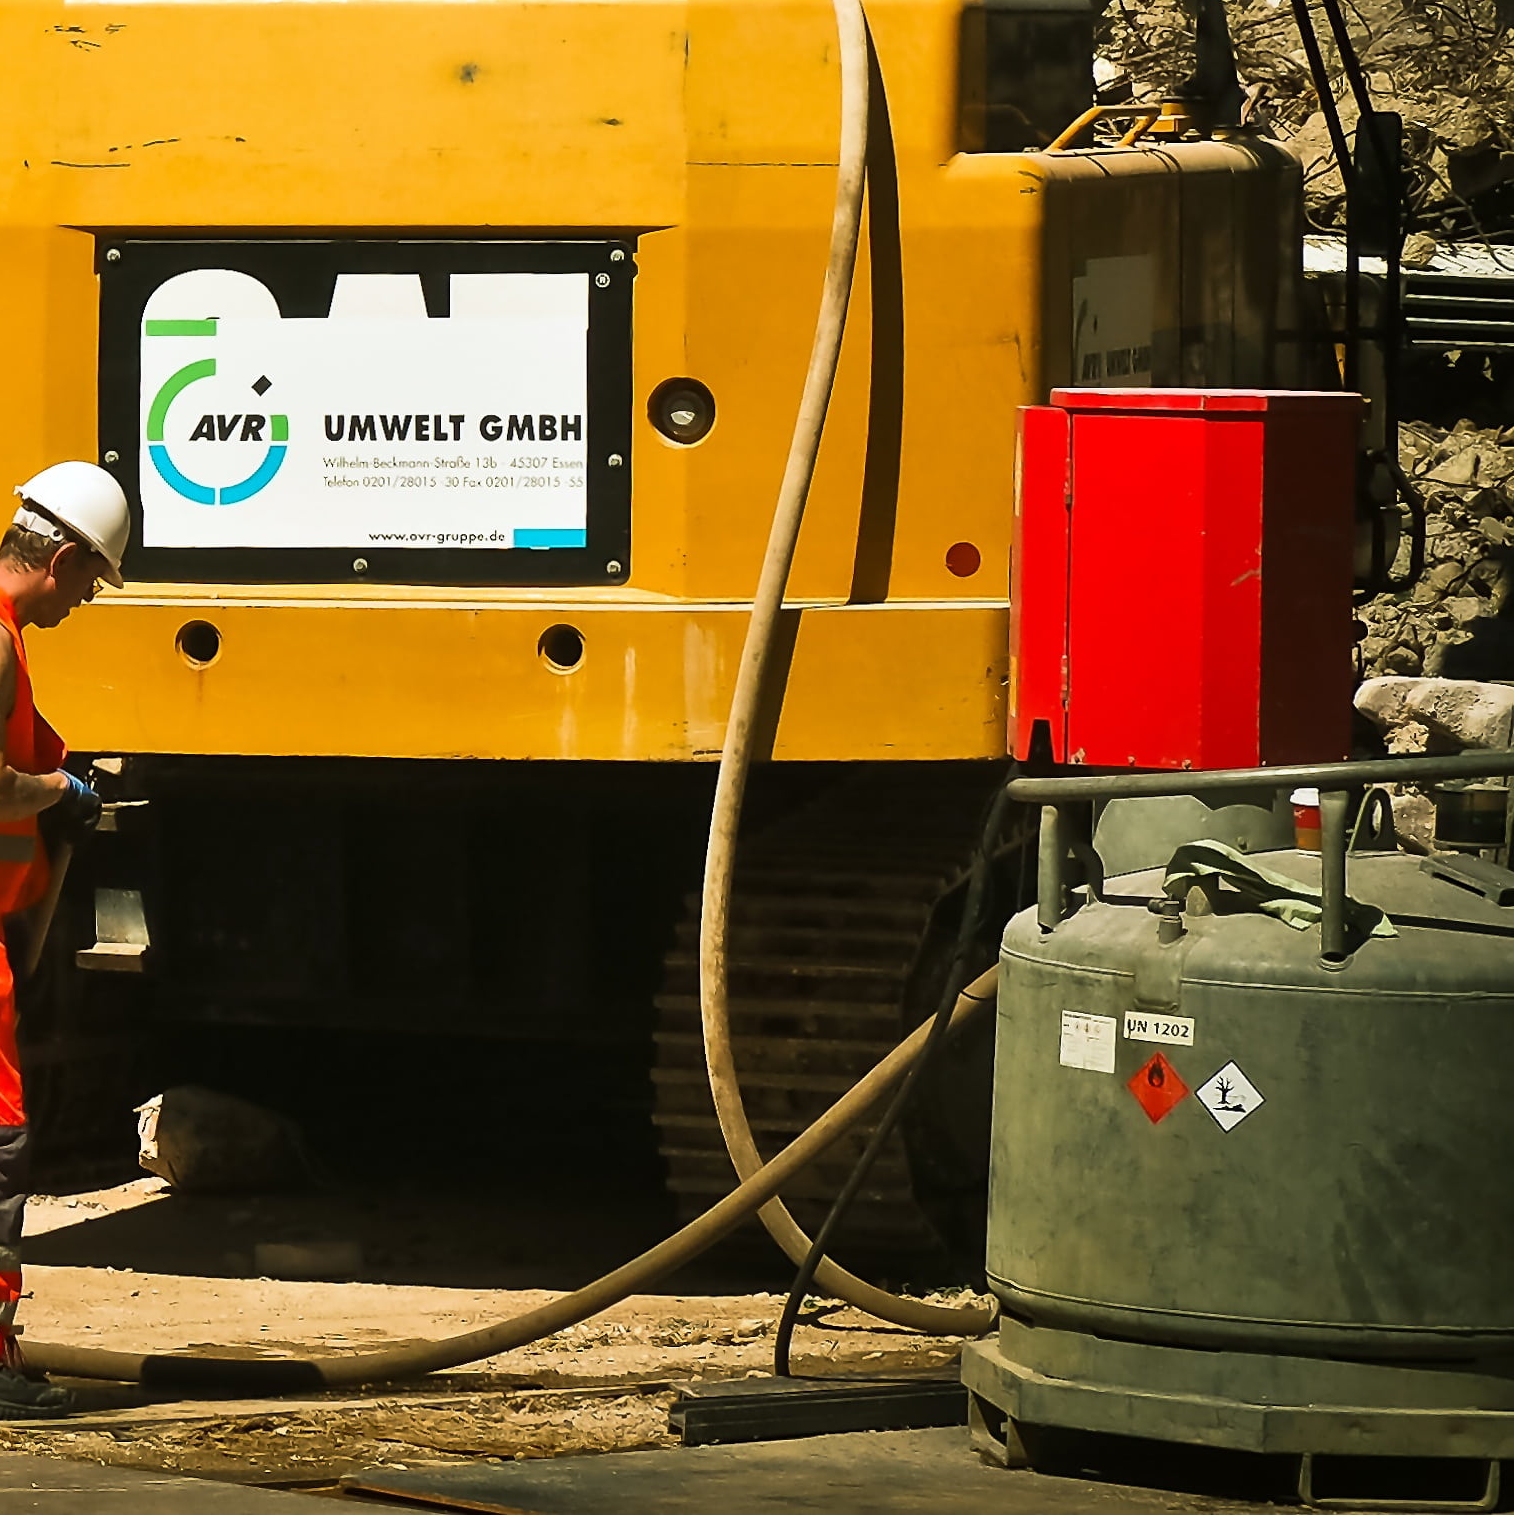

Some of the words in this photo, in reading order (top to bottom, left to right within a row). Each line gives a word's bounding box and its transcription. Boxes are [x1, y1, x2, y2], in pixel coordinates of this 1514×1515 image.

[189, 414, 266, 441] AVR
[324, 414, 465, 441] UMWELT
[479, 413, 582, 441] GMBH
[476, 456, 498, 469] 13b
[510, 456, 548, 469] 45307
[552, 456, 584, 469] Essen
[323, 475, 360, 488] Telefon
[463, 476, 483, 488] Fax
[1128, 1018, 1148, 1033] UN
[1154, 1022, 1189, 1038] 1202
